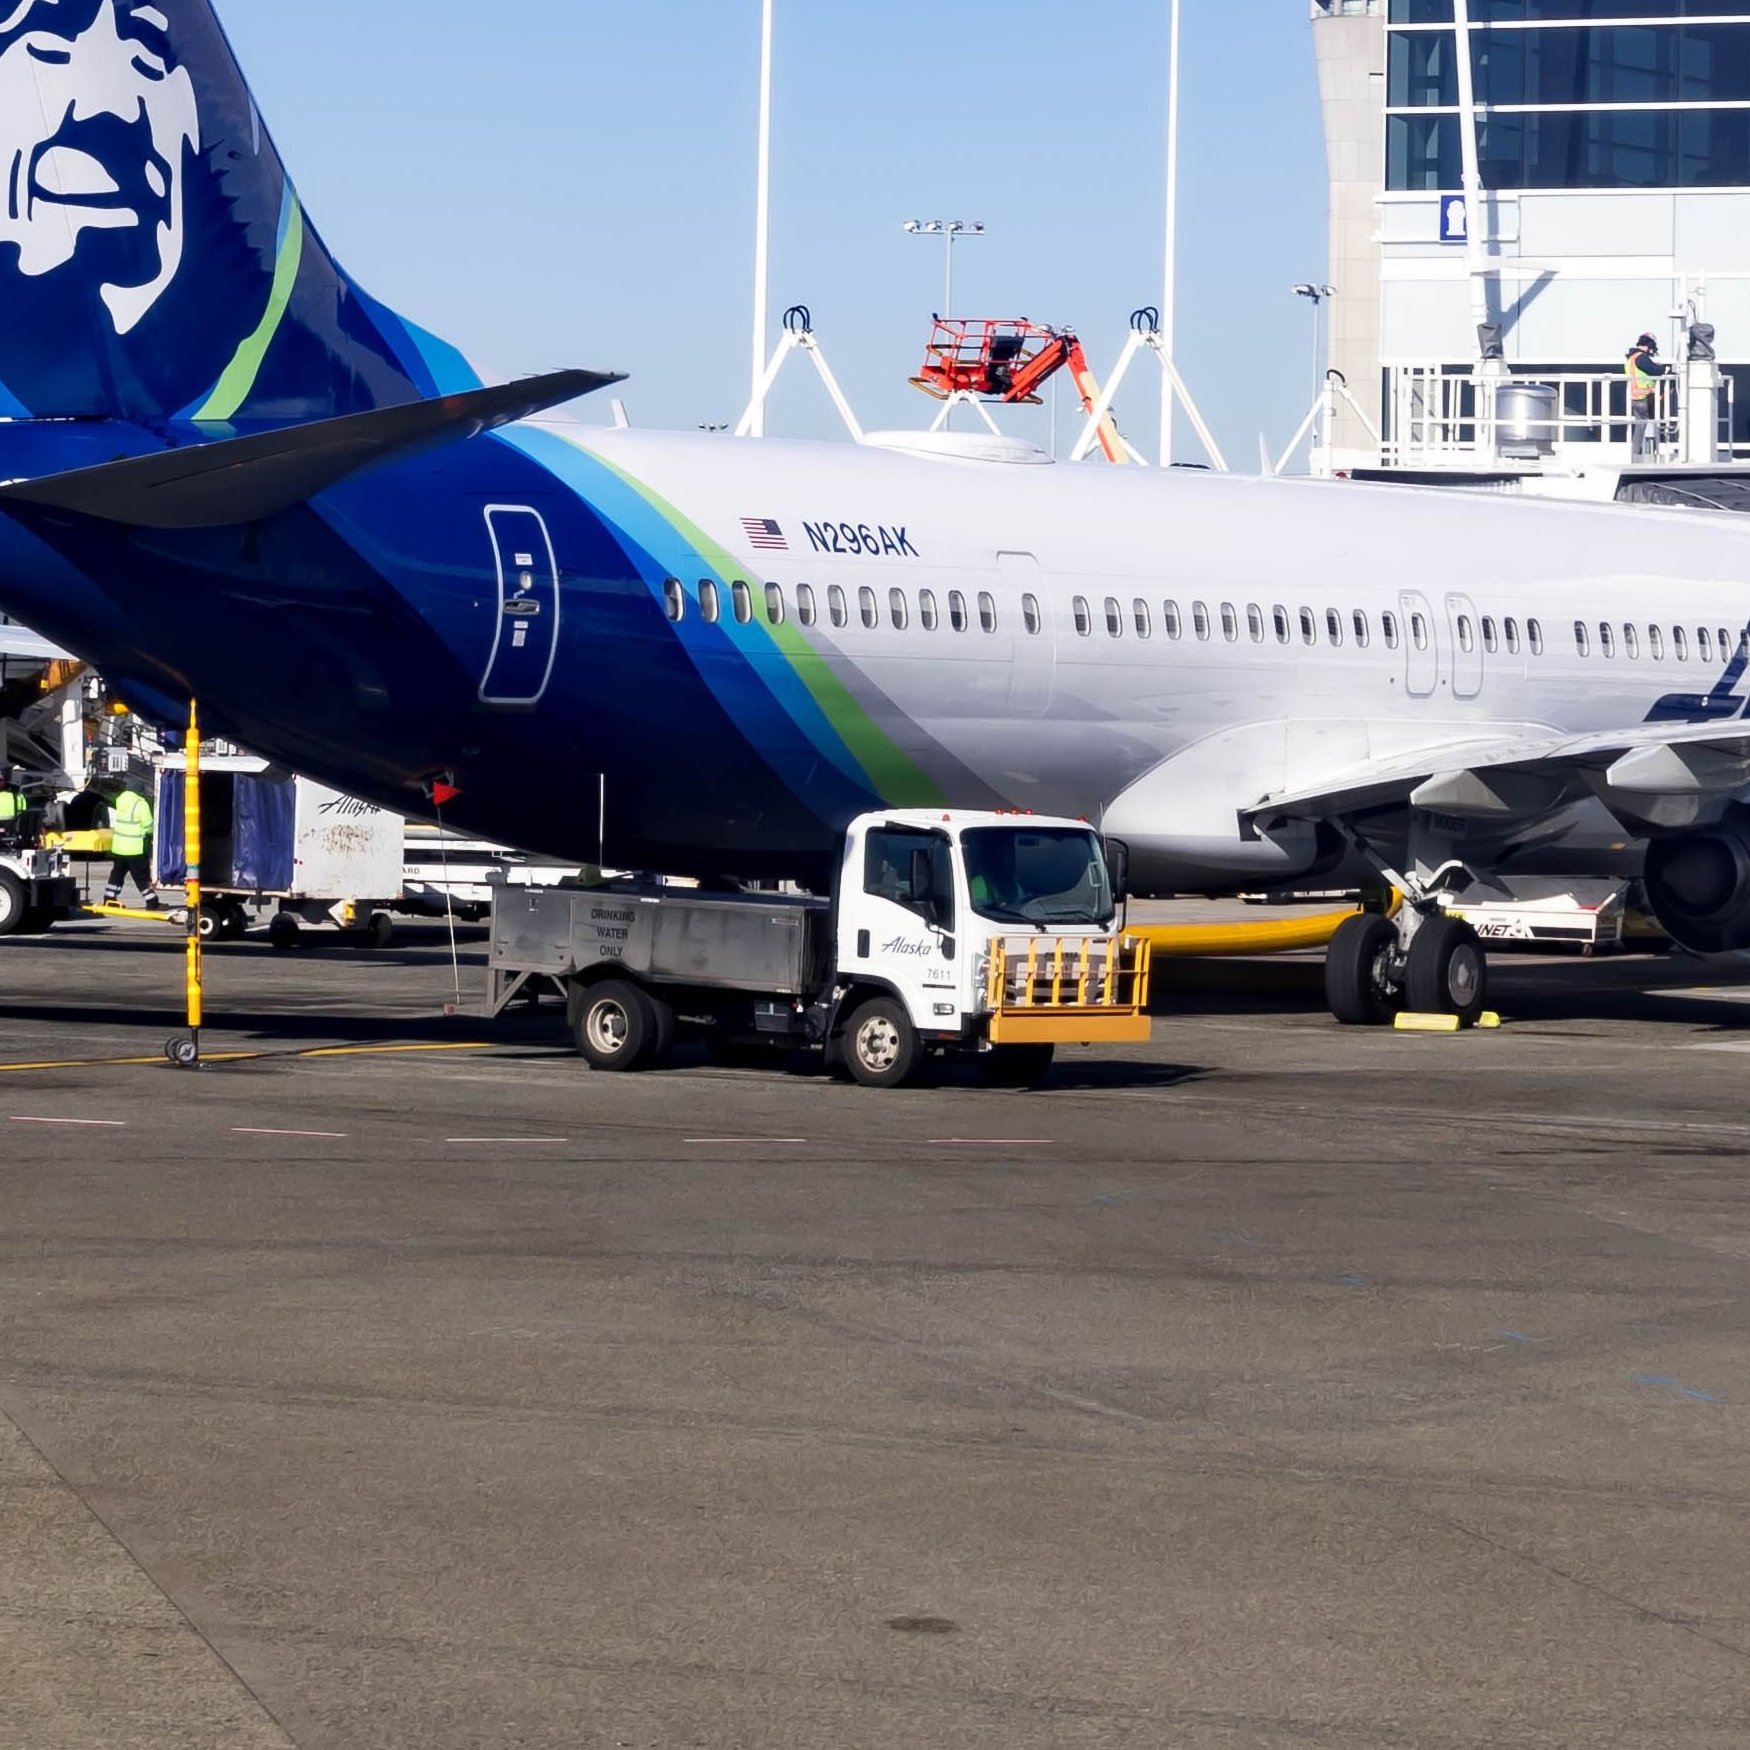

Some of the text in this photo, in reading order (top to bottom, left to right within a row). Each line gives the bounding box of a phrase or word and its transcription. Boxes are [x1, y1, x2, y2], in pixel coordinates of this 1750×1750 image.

[802, 521, 920, 557] N296AK
[591, 908, 636, 923] DRINKING
[597, 928, 628, 940] WATER
[599, 945, 624, 957] ONLY
[881, 936, 932, 958] Alaska
[927, 968, 951, 980] 7611
